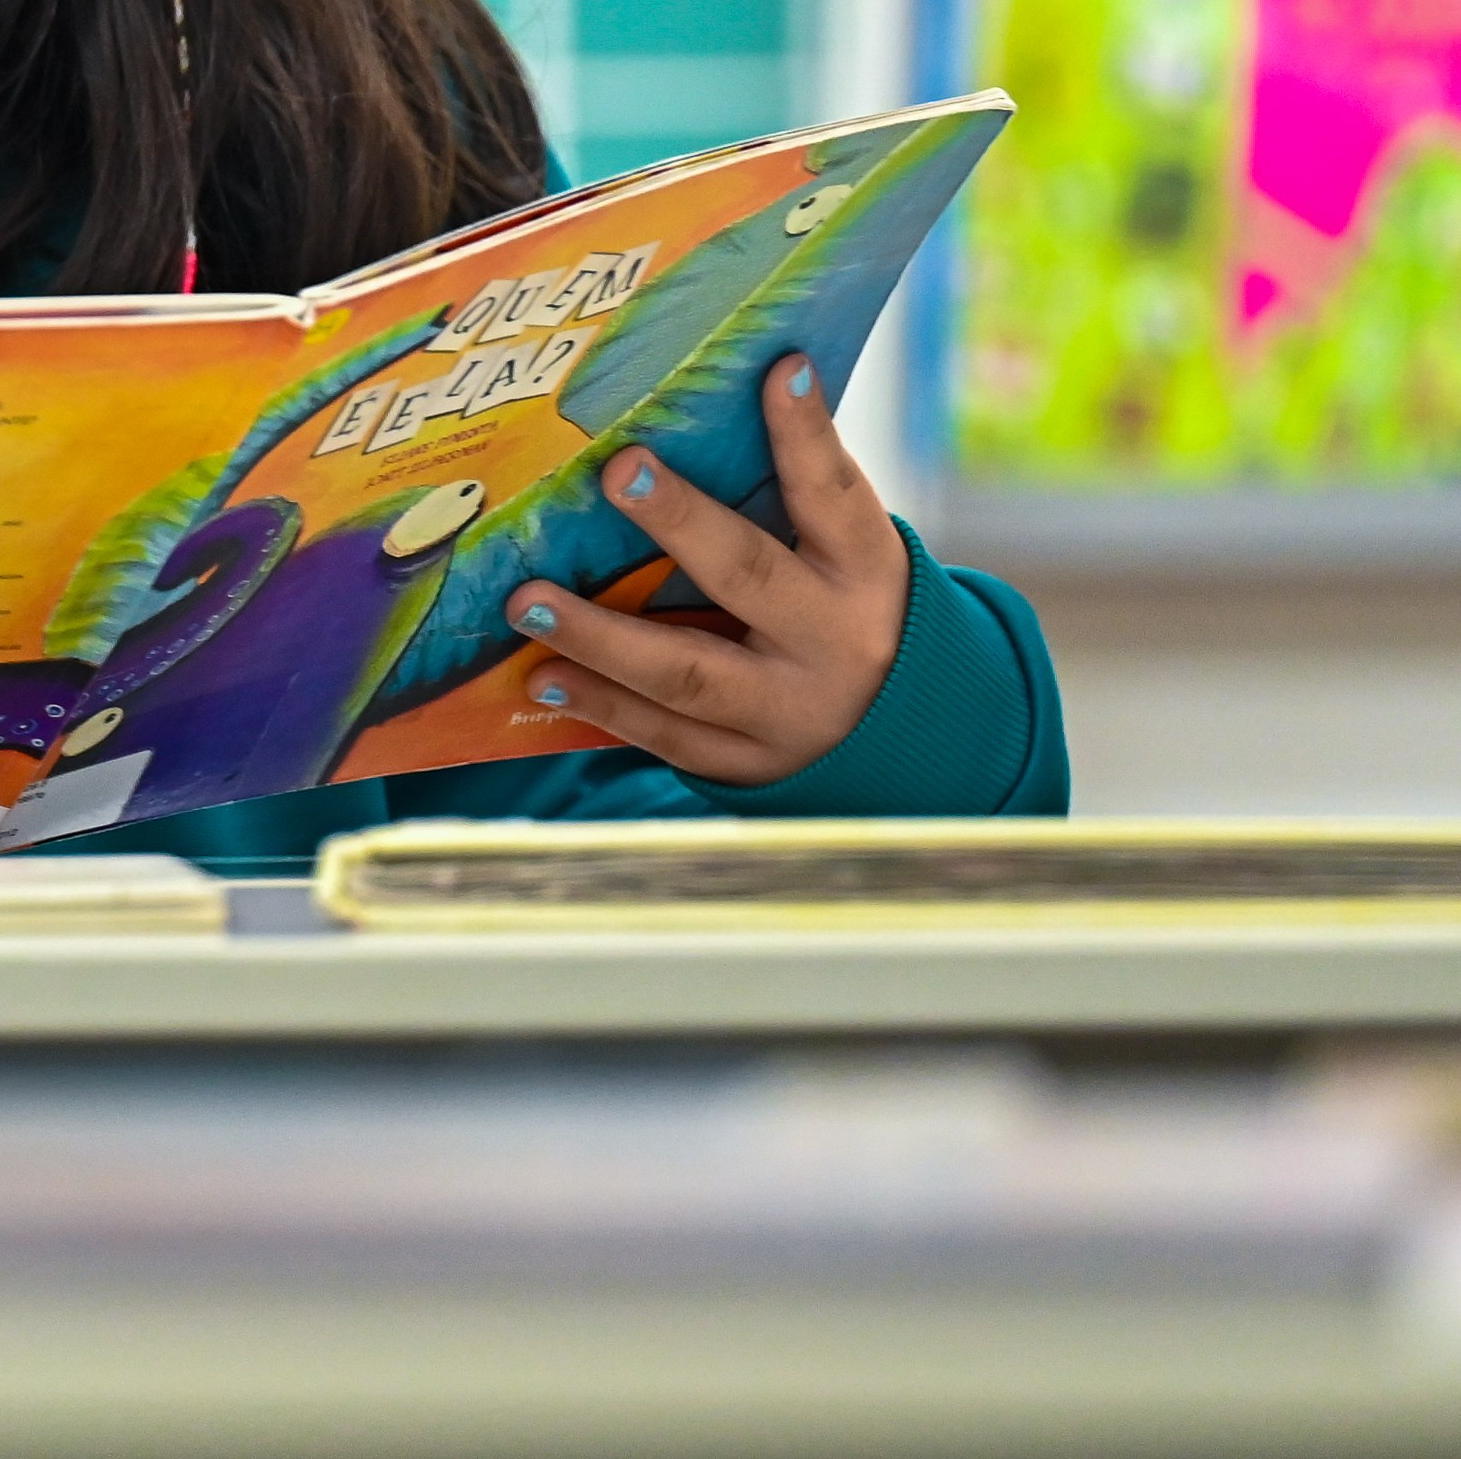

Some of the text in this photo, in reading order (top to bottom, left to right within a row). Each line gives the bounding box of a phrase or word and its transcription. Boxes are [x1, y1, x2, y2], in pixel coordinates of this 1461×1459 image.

[452, 256, 644, 335] QUEM
[332, 339, 575, 438] É ELA?
